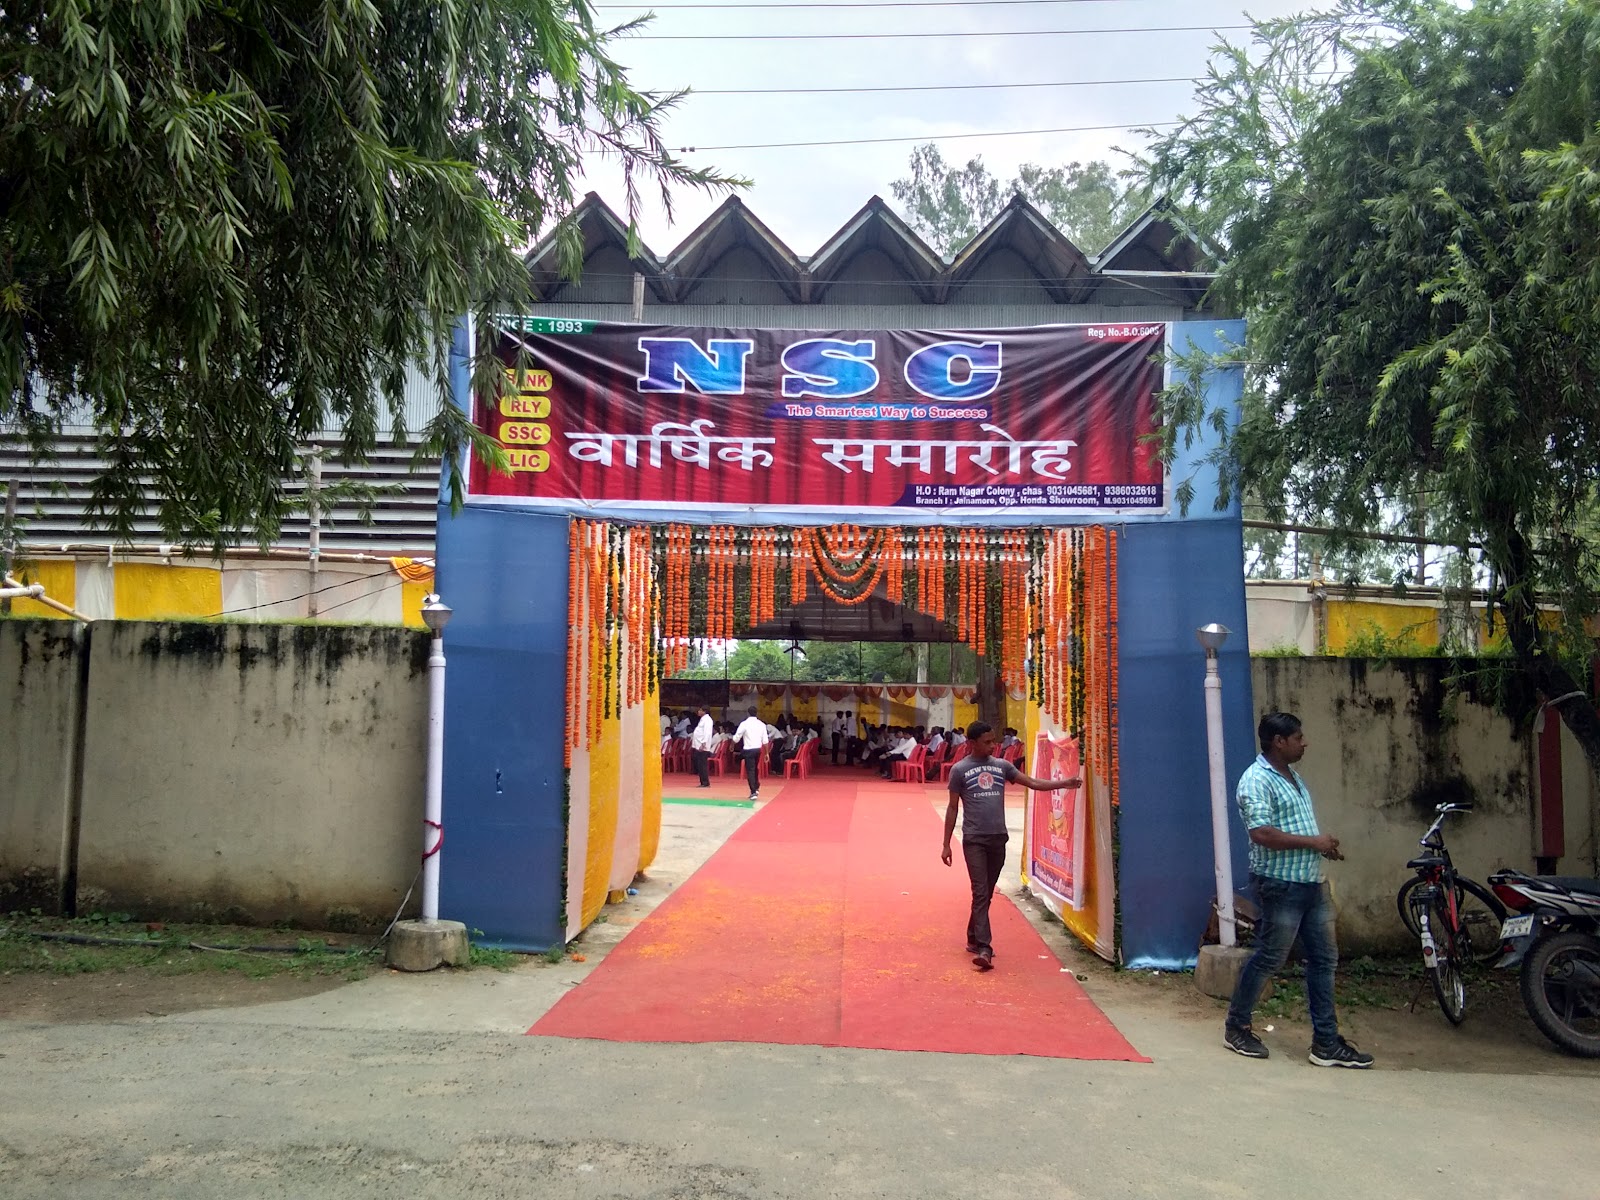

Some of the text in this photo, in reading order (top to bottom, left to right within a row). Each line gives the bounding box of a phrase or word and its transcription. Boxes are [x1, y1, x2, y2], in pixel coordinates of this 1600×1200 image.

[548, 320, 583, 333] 1993
[1087, 328, 1106, 339] Reg.
[510, 400, 542, 414] RLY
[786, 405, 988, 420] The Smartest Way to Success
[508, 426, 543, 440] SSC
[563, 419, 1079, 481] वार्षिक समारोह
[509, 453, 541, 468] LIC
[915, 485, 932, 495] H.O
[938, 486, 958, 496] Ram
[959, 486, 985, 497] Nagar
[1021, 486, 1043, 496] chas
[1104, 485, 1157, 496] 9386032618
[915, 496, 943, 504] Branch
[998, 496, 1019, 506] Opp.
[1020, 496, 1048, 505] Honda
[964, 766, 982, 778] NEW
